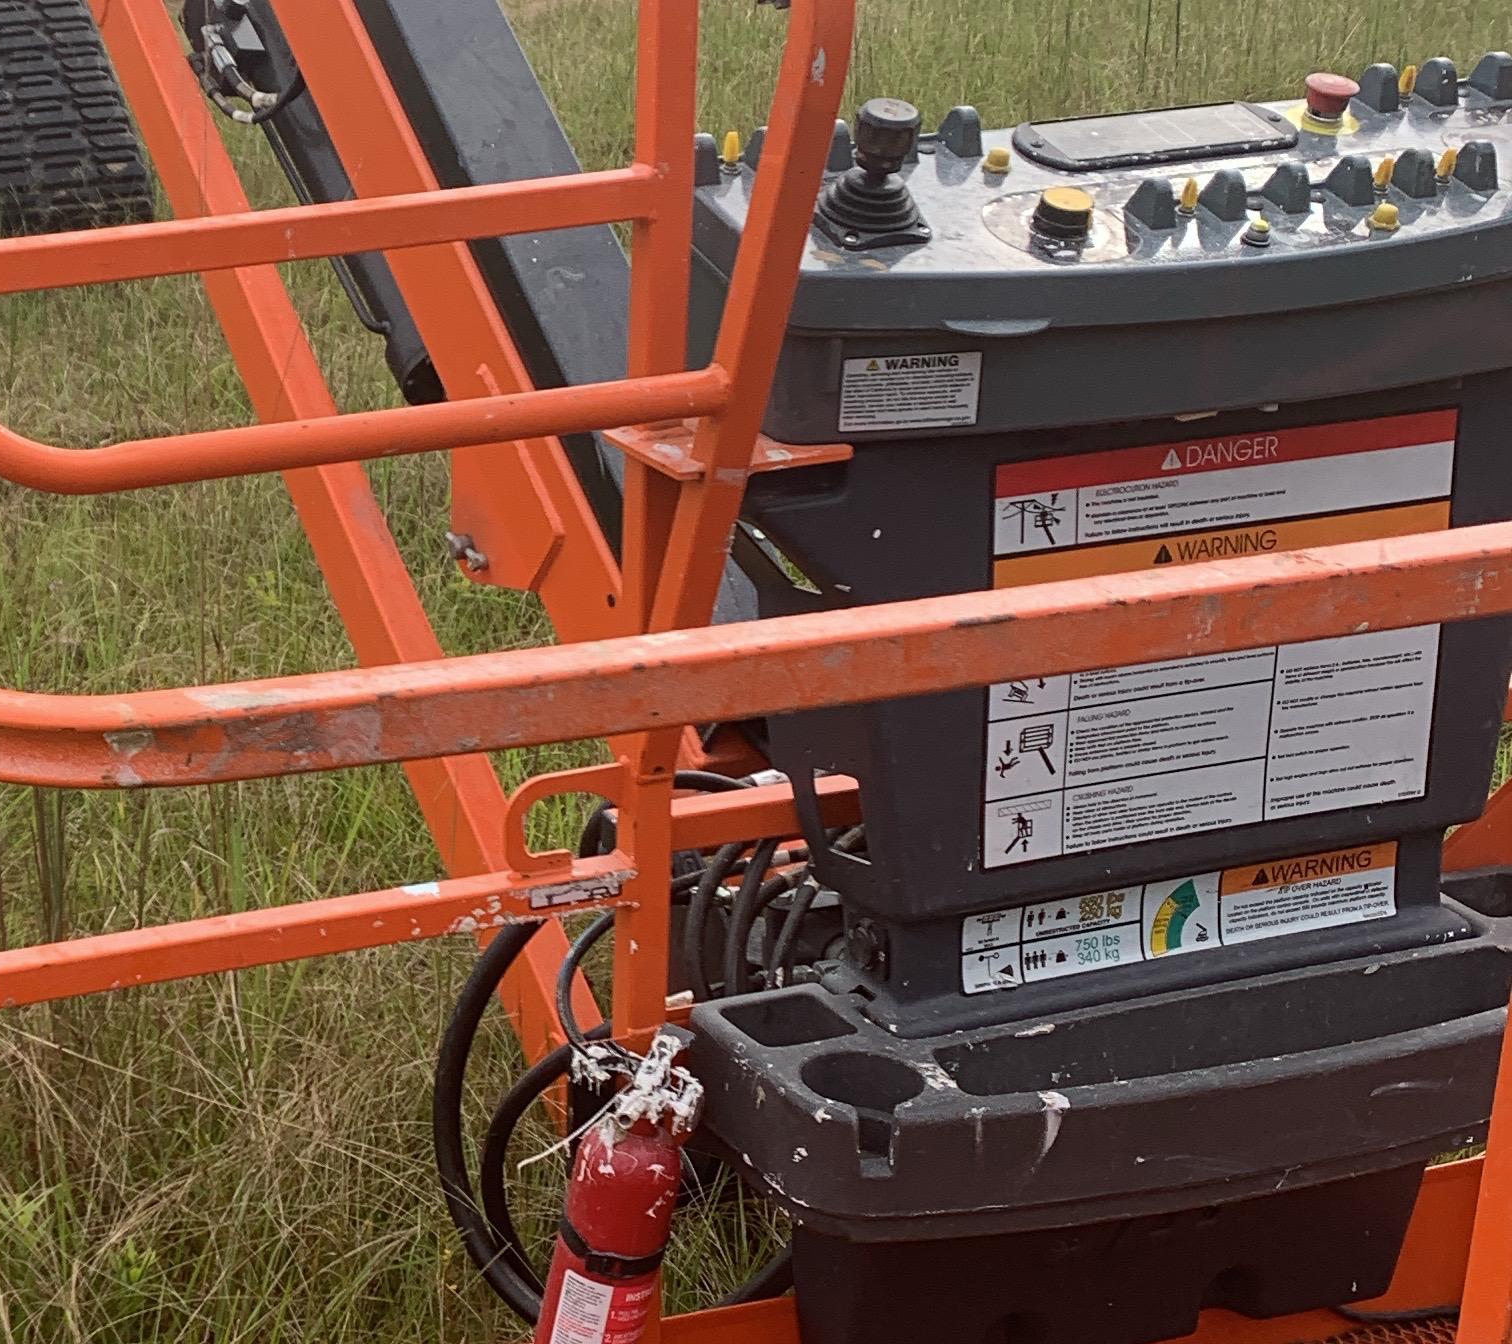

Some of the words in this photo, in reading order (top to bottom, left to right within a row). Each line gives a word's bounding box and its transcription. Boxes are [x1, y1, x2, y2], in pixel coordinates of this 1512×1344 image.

[885, 355, 959, 370] WARNING
[1187, 436, 1278, 467] DANGER
[1177, 530, 1277, 558] WARNING
[1271, 850, 1372, 882] WARNING
[1075, 937, 1099, 952] 750
[1102, 933, 1120, 949] lbs
[1077, 951, 1101, 965] 340
[1105, 946, 1120, 961] kg
